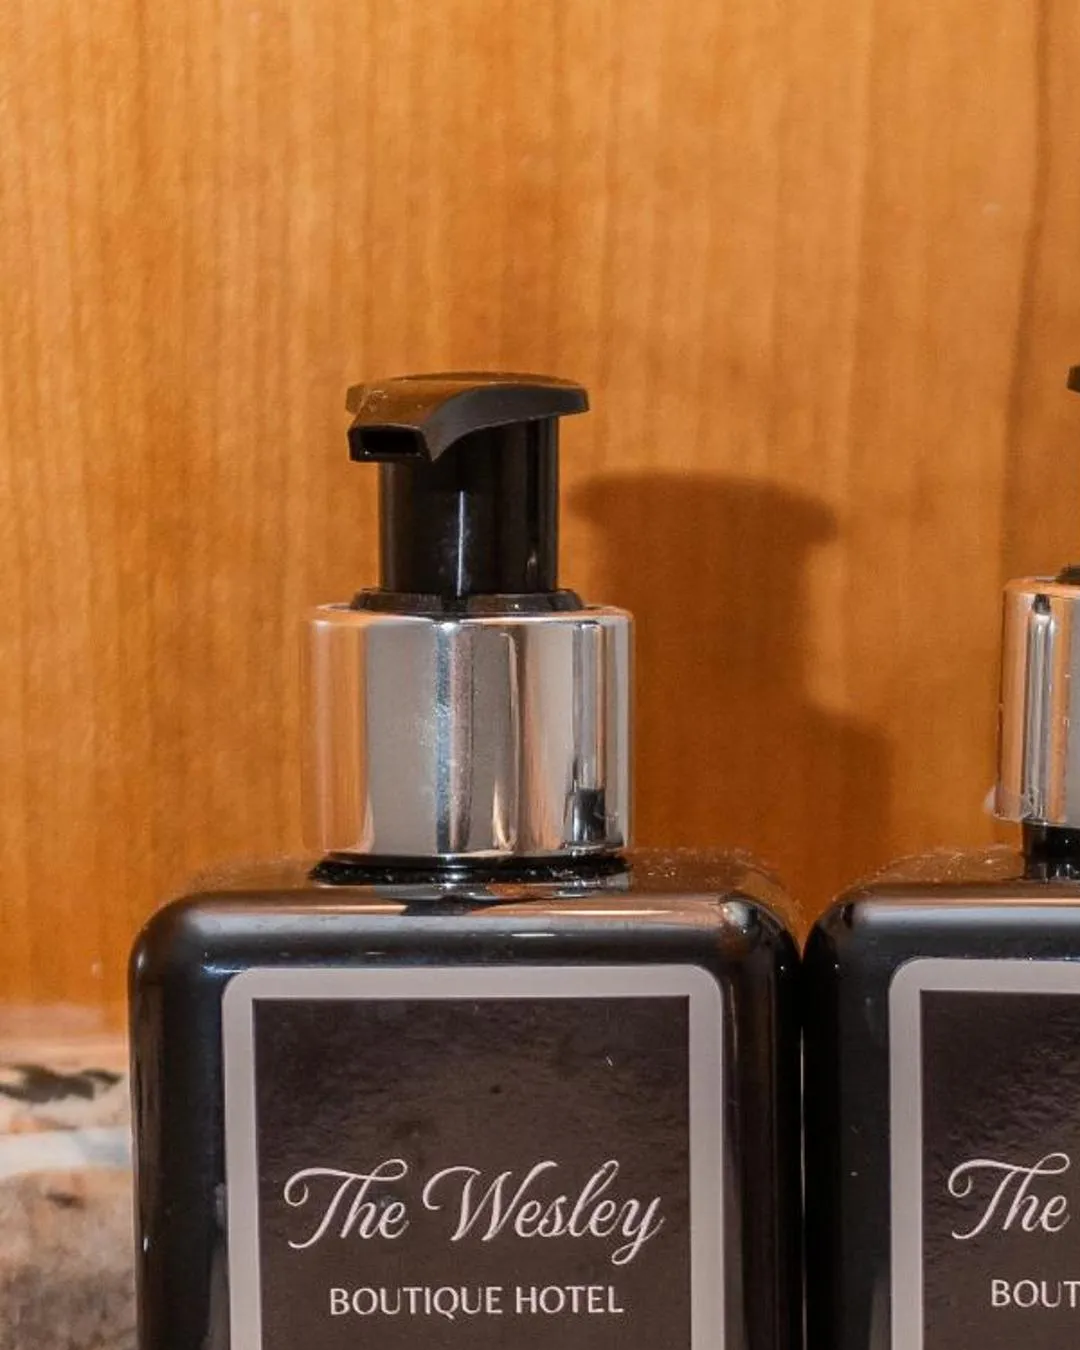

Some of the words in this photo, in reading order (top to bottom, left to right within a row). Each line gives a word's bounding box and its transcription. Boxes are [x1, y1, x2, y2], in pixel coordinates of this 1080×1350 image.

[283, 1158, 409, 1249] The
[422, 1159, 661, 1266] Wesley
[947, 1152, 1071, 1240] The
[330, 1286, 503, 1320] BOUTIQUE
[515, 1285, 624, 1314] HOTEL
